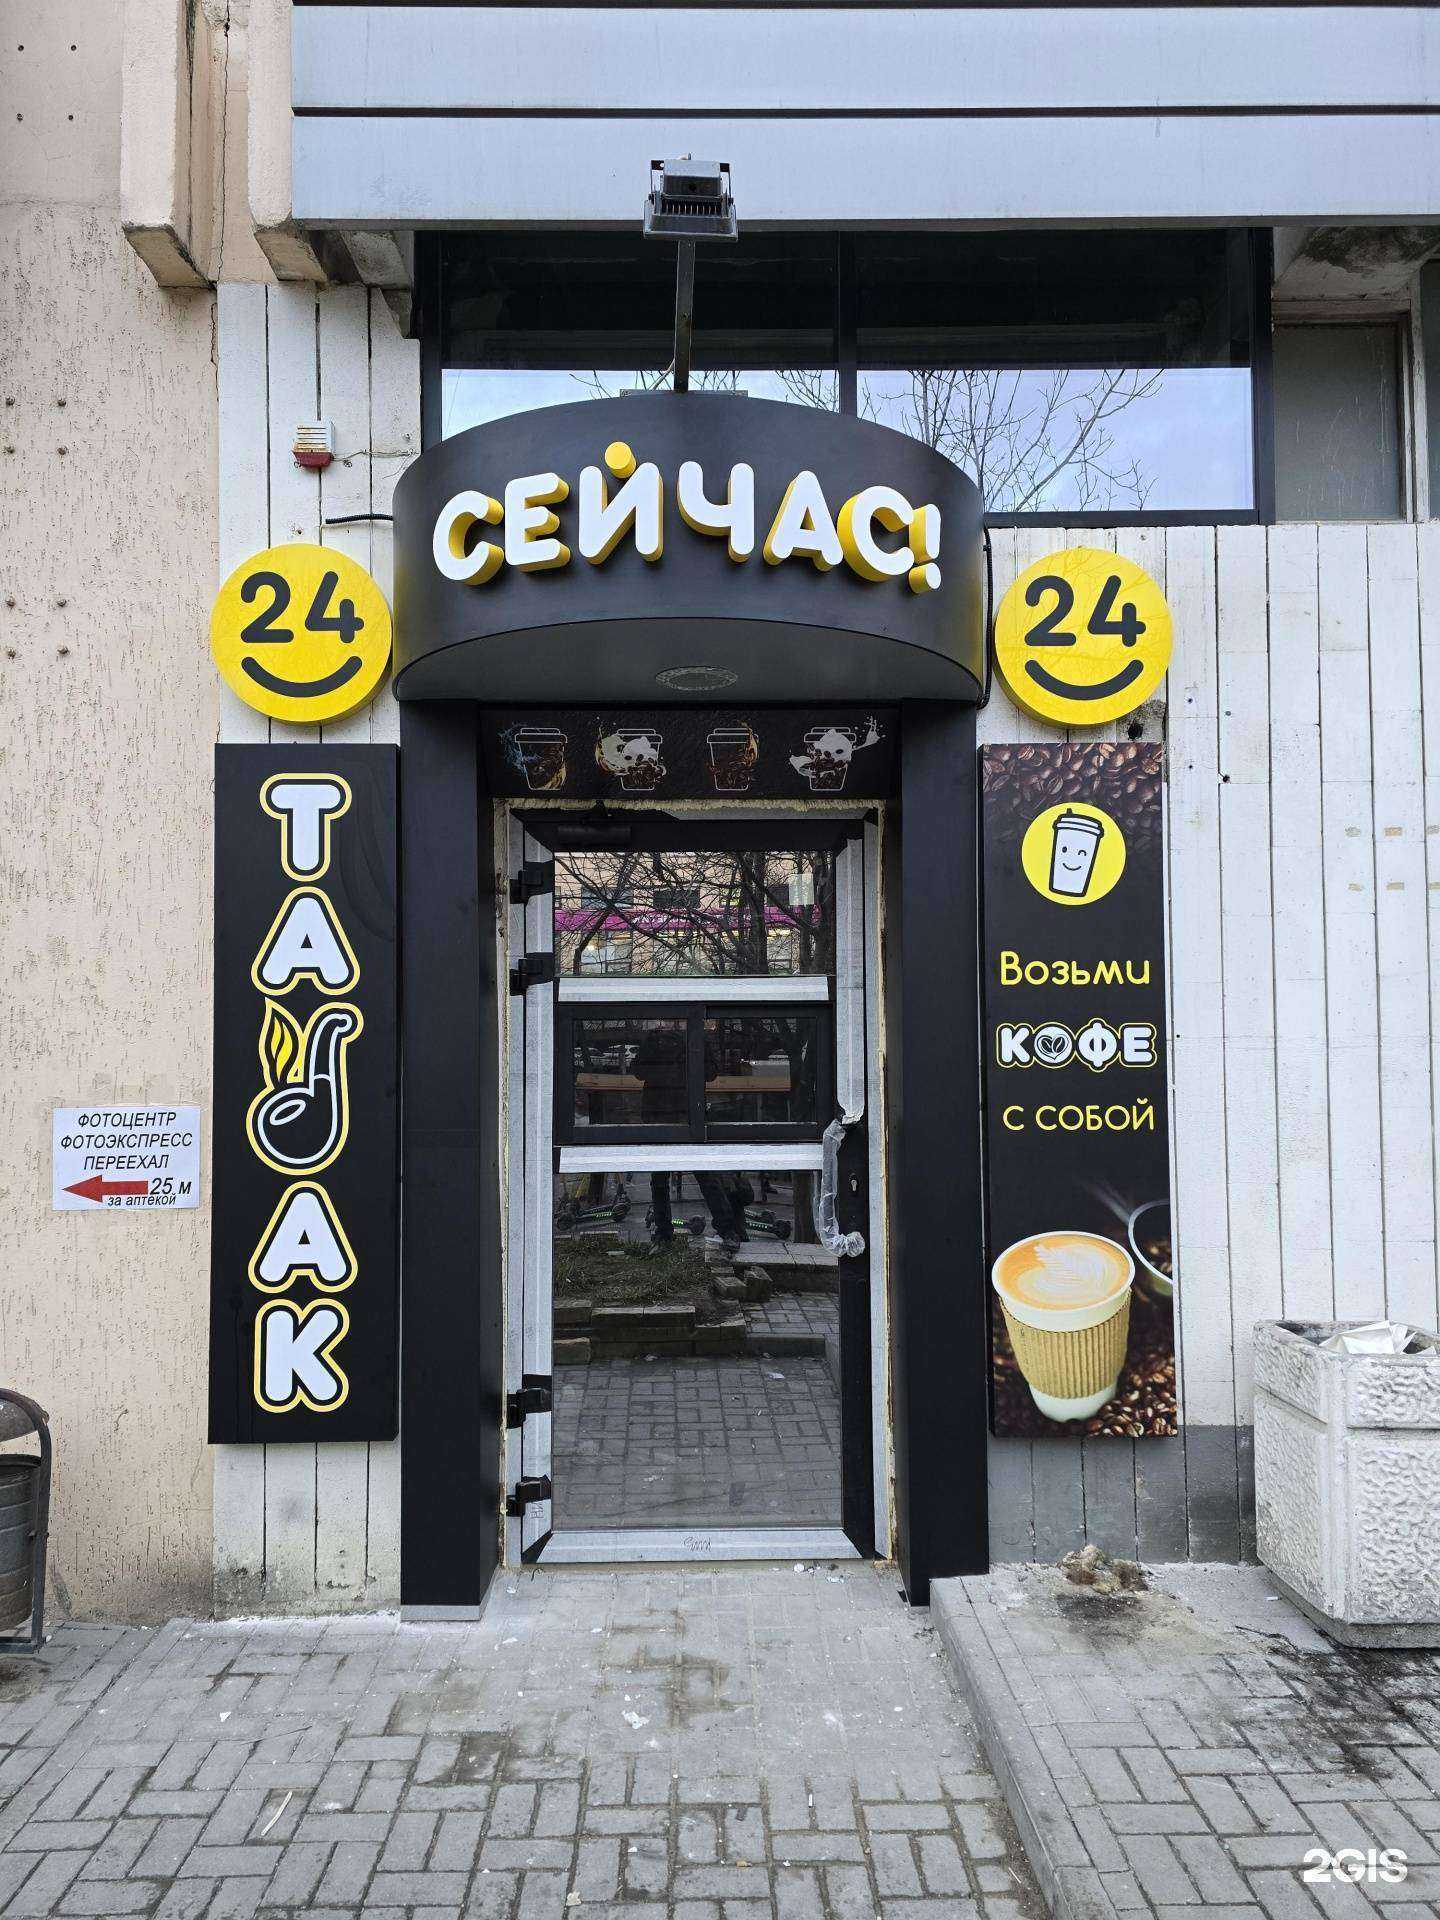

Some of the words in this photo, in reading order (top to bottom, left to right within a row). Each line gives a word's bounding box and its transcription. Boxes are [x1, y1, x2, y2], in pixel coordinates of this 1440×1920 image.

[432, 441, 942, 592] СЕЙЧАС!
[239, 571, 365, 645] 24
[1024, 574, 1147, 647] 24
[1000, 950, 1150, 987] Возьми
[996, 1018, 1158, 1073] КОФЕ
[78, 1111, 177, 1130] ФОТОЦЕНТР
[60, 1132, 193, 1149] ФОТОЭКСПРЕСС
[83, 1154, 170, 1171] ПЕРЕЕХАЛ
[107, 1196, 122, 1206] за
[125, 1192, 177, 1206] аптекой
